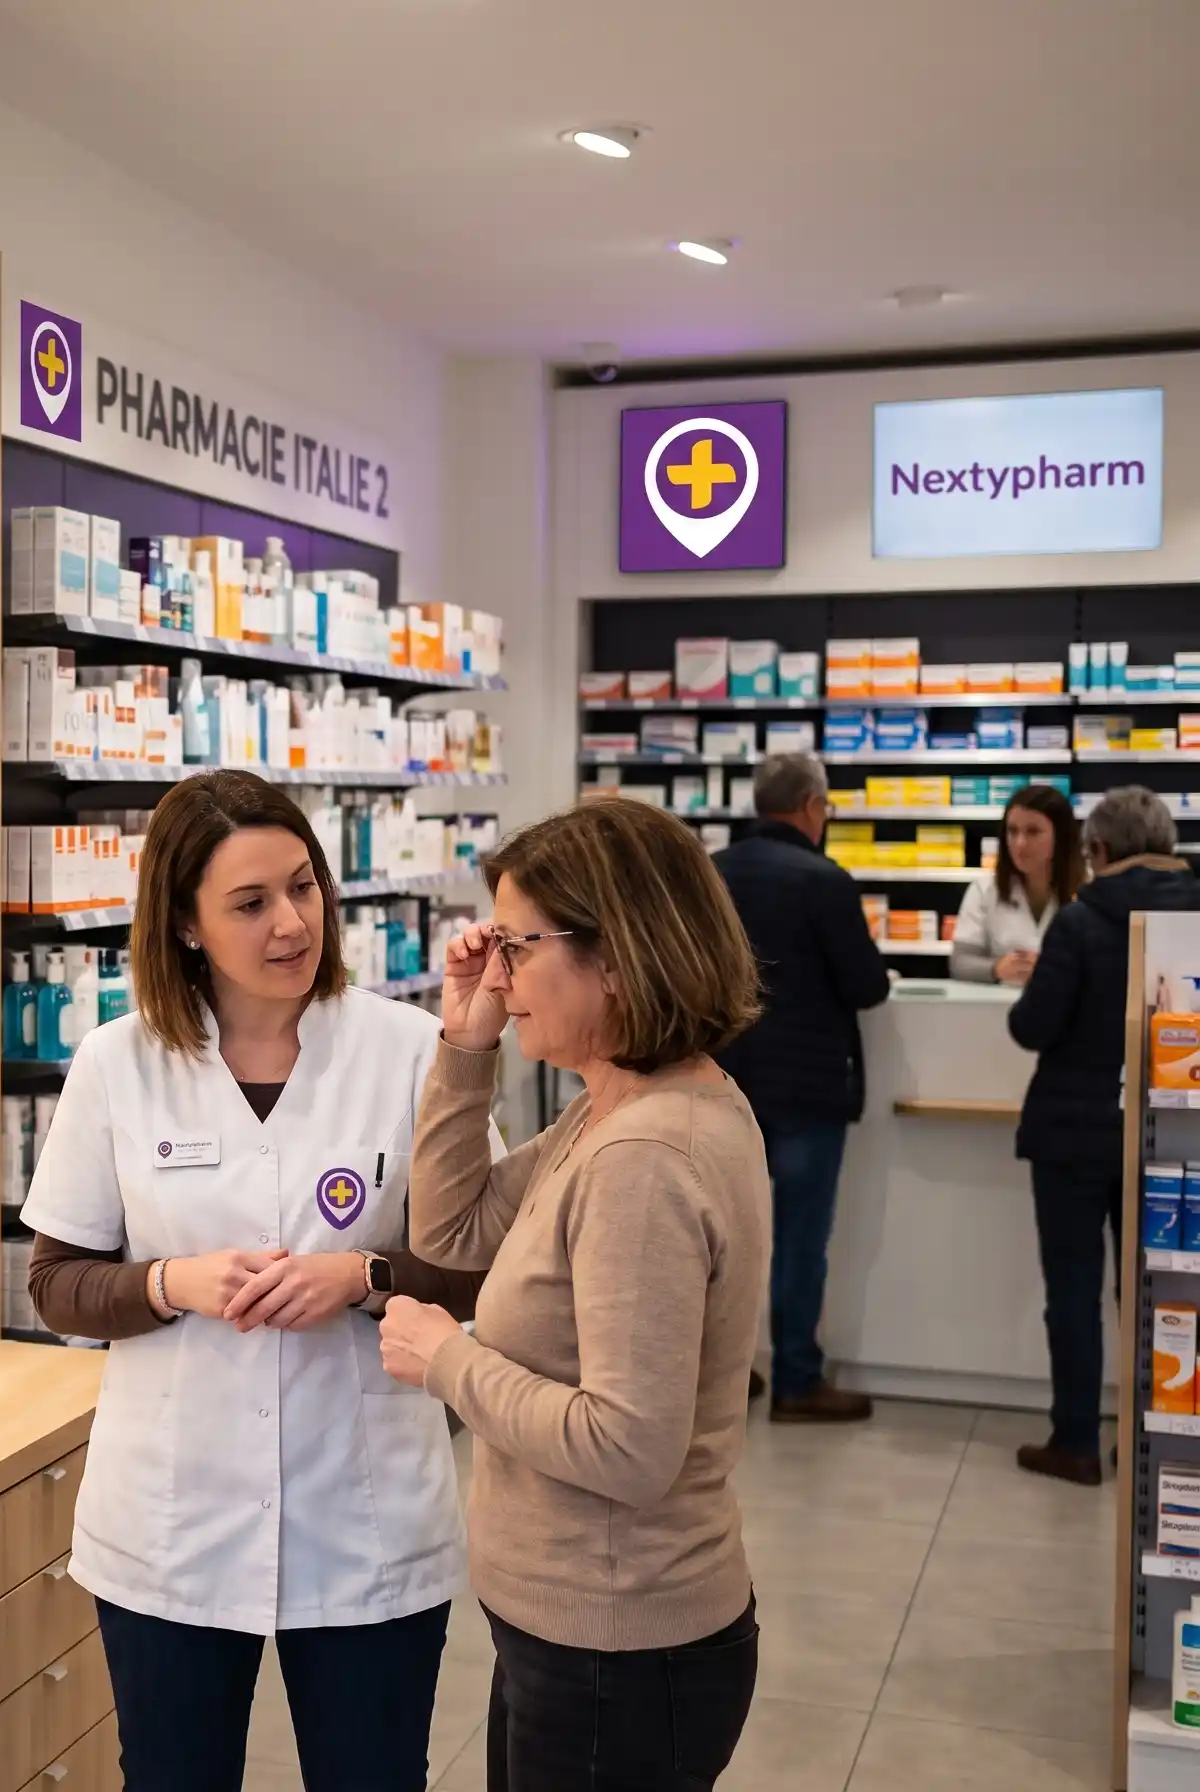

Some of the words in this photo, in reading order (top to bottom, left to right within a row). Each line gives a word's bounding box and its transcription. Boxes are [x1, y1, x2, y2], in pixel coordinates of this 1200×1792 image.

[96, 356, 286, 486] PHARMACIE
[293, 432, 370, 512] ITALIE
[375, 464, 389, 518] 2
[890, 454, 1146, 500] Nextypharm
